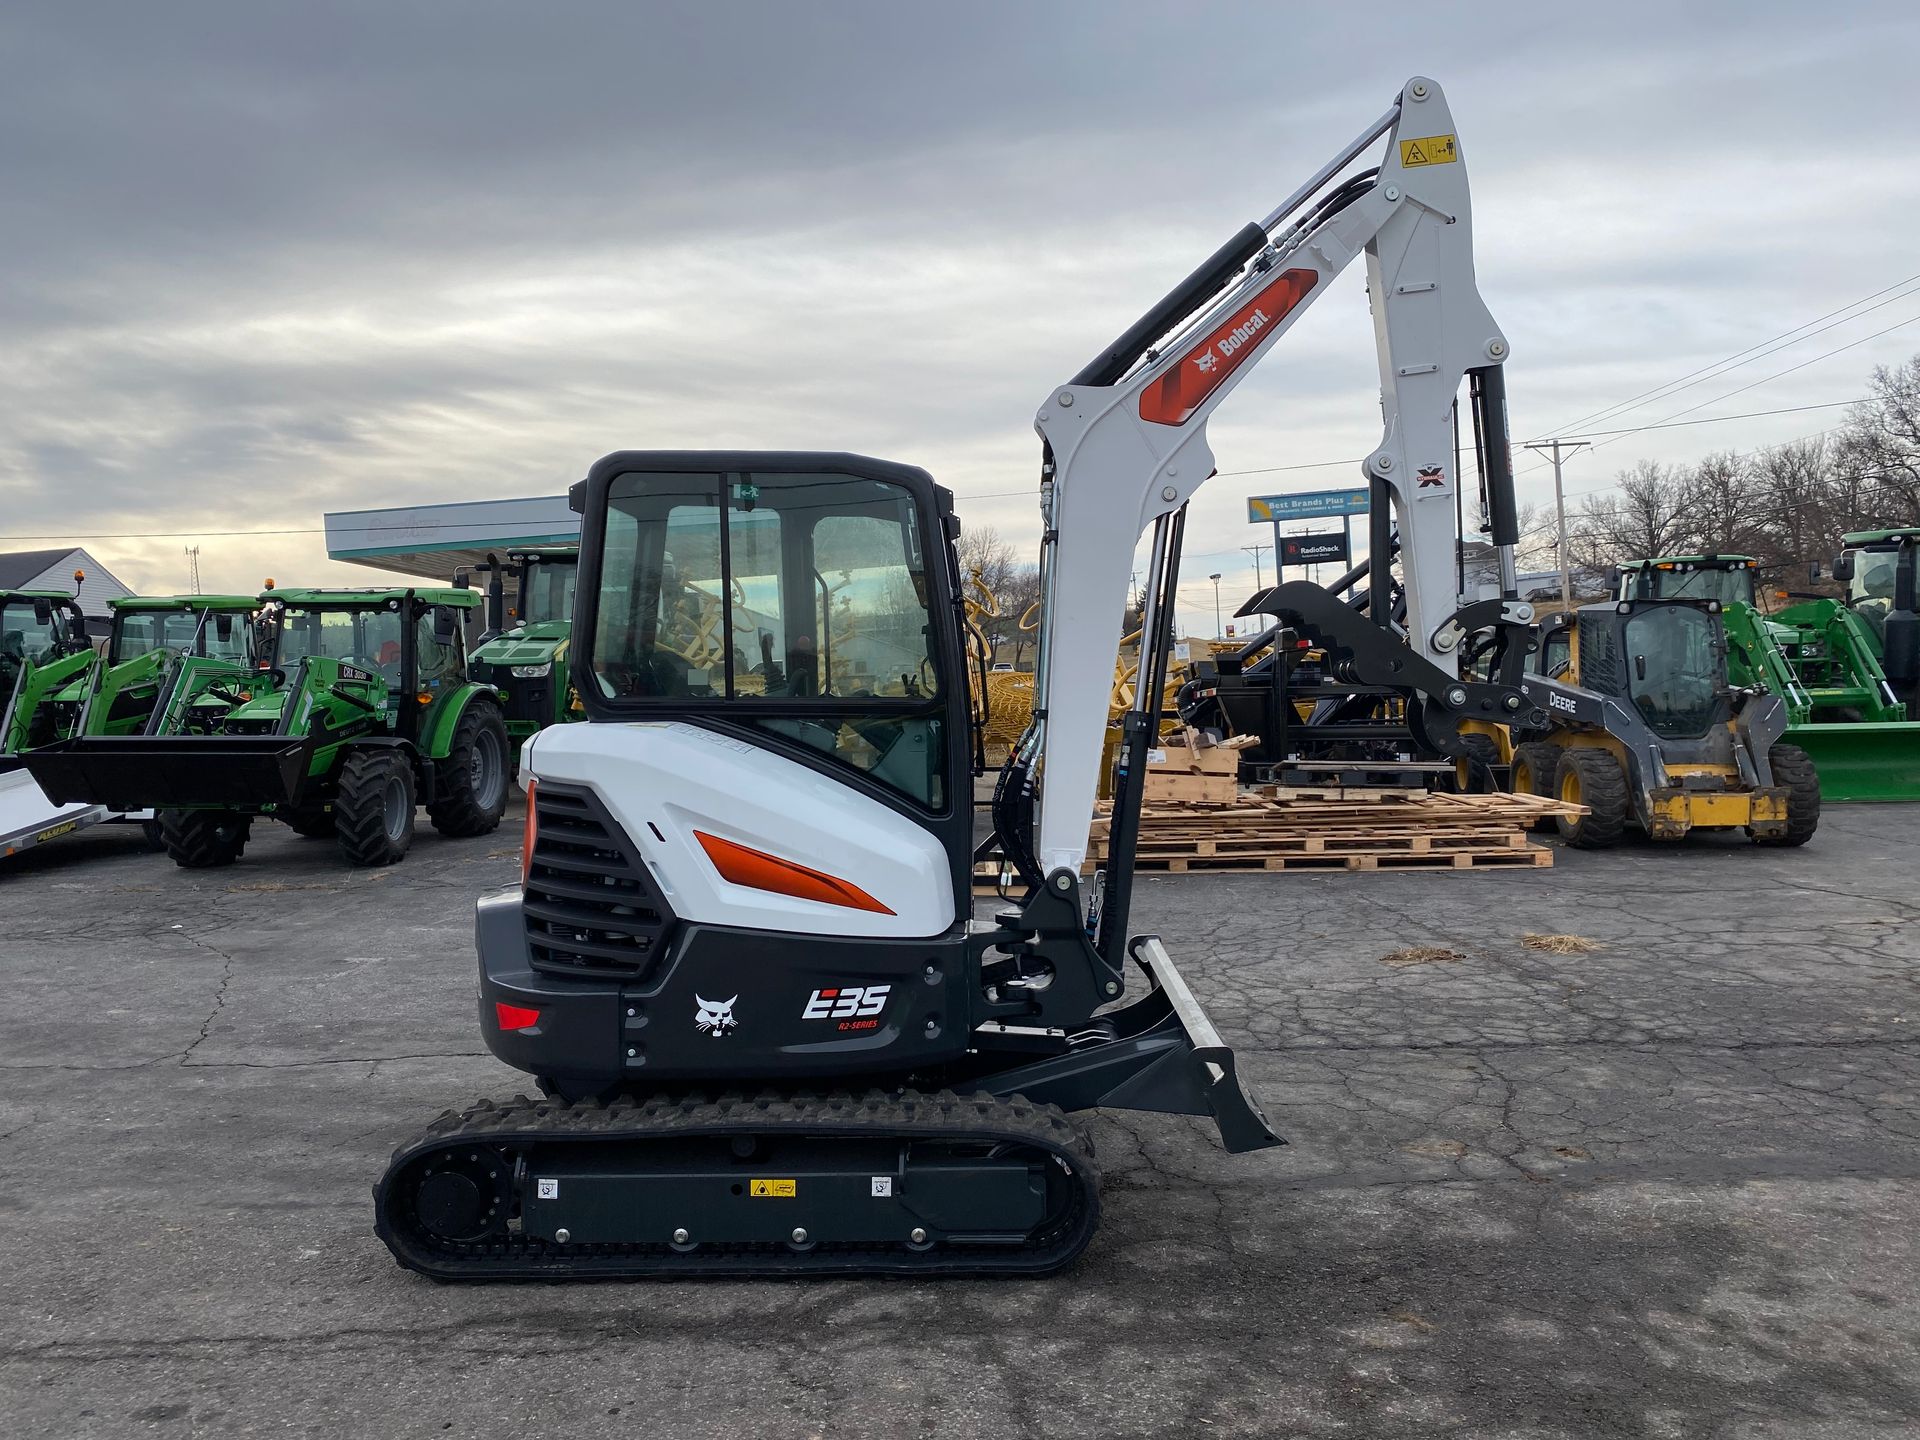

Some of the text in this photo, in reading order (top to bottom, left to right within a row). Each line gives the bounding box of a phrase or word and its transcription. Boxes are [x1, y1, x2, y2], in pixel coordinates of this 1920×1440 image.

[1217, 308, 1269, 357] Bobcat
[1291, 498, 1322, 508] Brands
[1300, 545, 1339, 554] RadioShack
[343, 666, 367, 680] CRX 3030
[1550, 691, 1577, 714] DEERE
[802, 985, 892, 1019] E35
[838, 1020, 878, 1030] R2-SERIES
